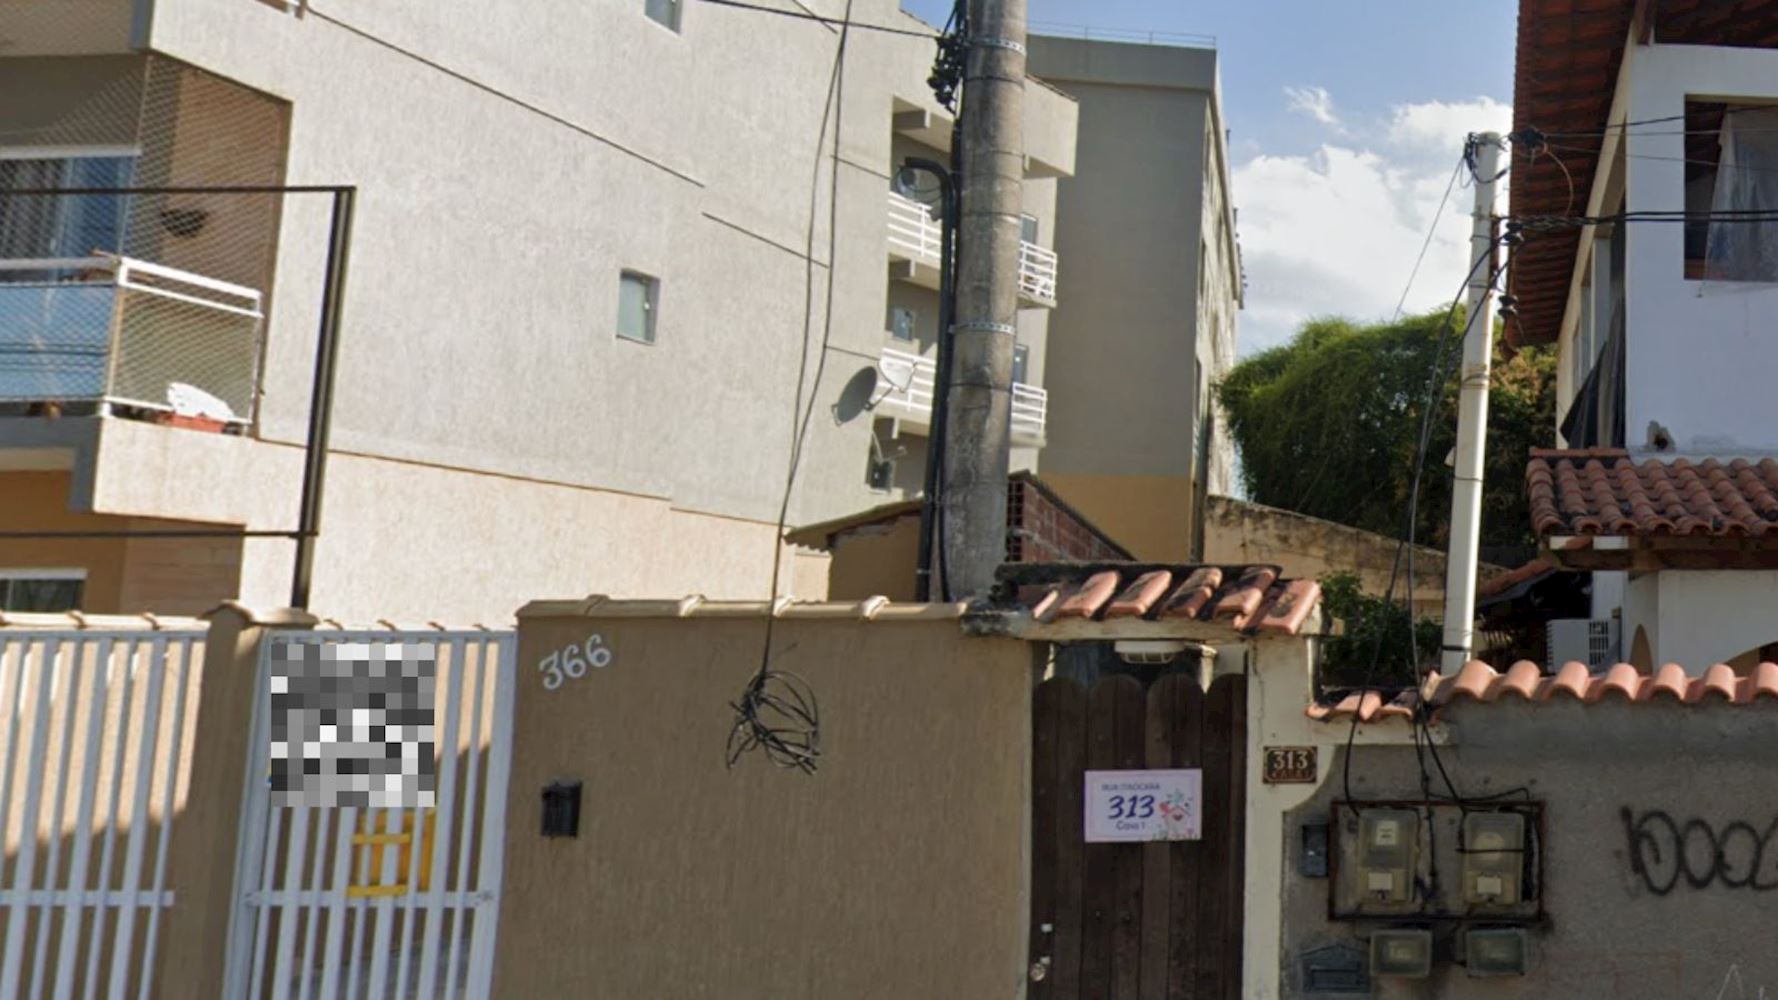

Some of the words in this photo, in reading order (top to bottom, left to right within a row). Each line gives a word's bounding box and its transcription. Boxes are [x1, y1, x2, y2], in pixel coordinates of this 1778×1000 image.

[538, 633, 612, 690] 366
[1273, 751, 1308, 769] 313
[1108, 794, 1155, 819] 313
